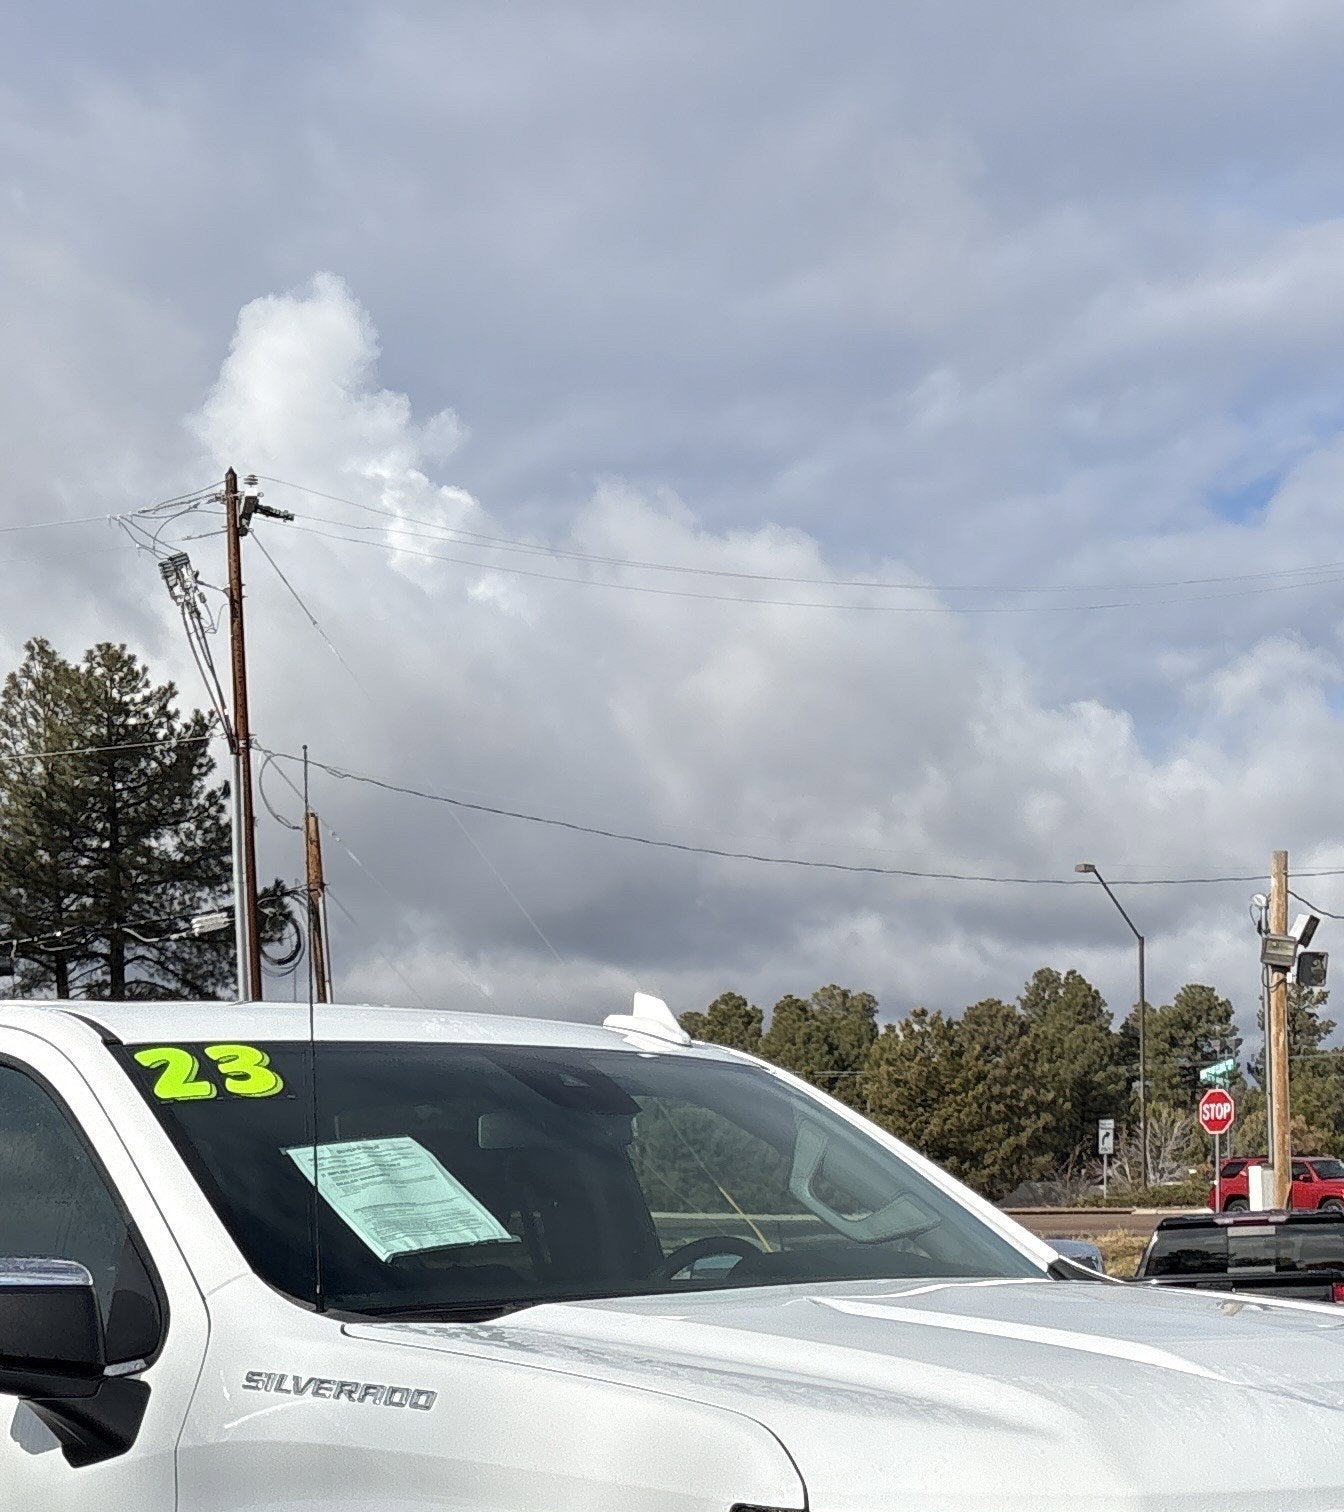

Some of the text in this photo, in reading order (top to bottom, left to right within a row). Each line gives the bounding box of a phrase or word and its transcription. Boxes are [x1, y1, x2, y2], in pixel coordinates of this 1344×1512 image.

[133, 1044, 284, 1101] 23
[1202, 1102, 1231, 1121] STOP
[241, 1370, 439, 1411] SILVERADO
